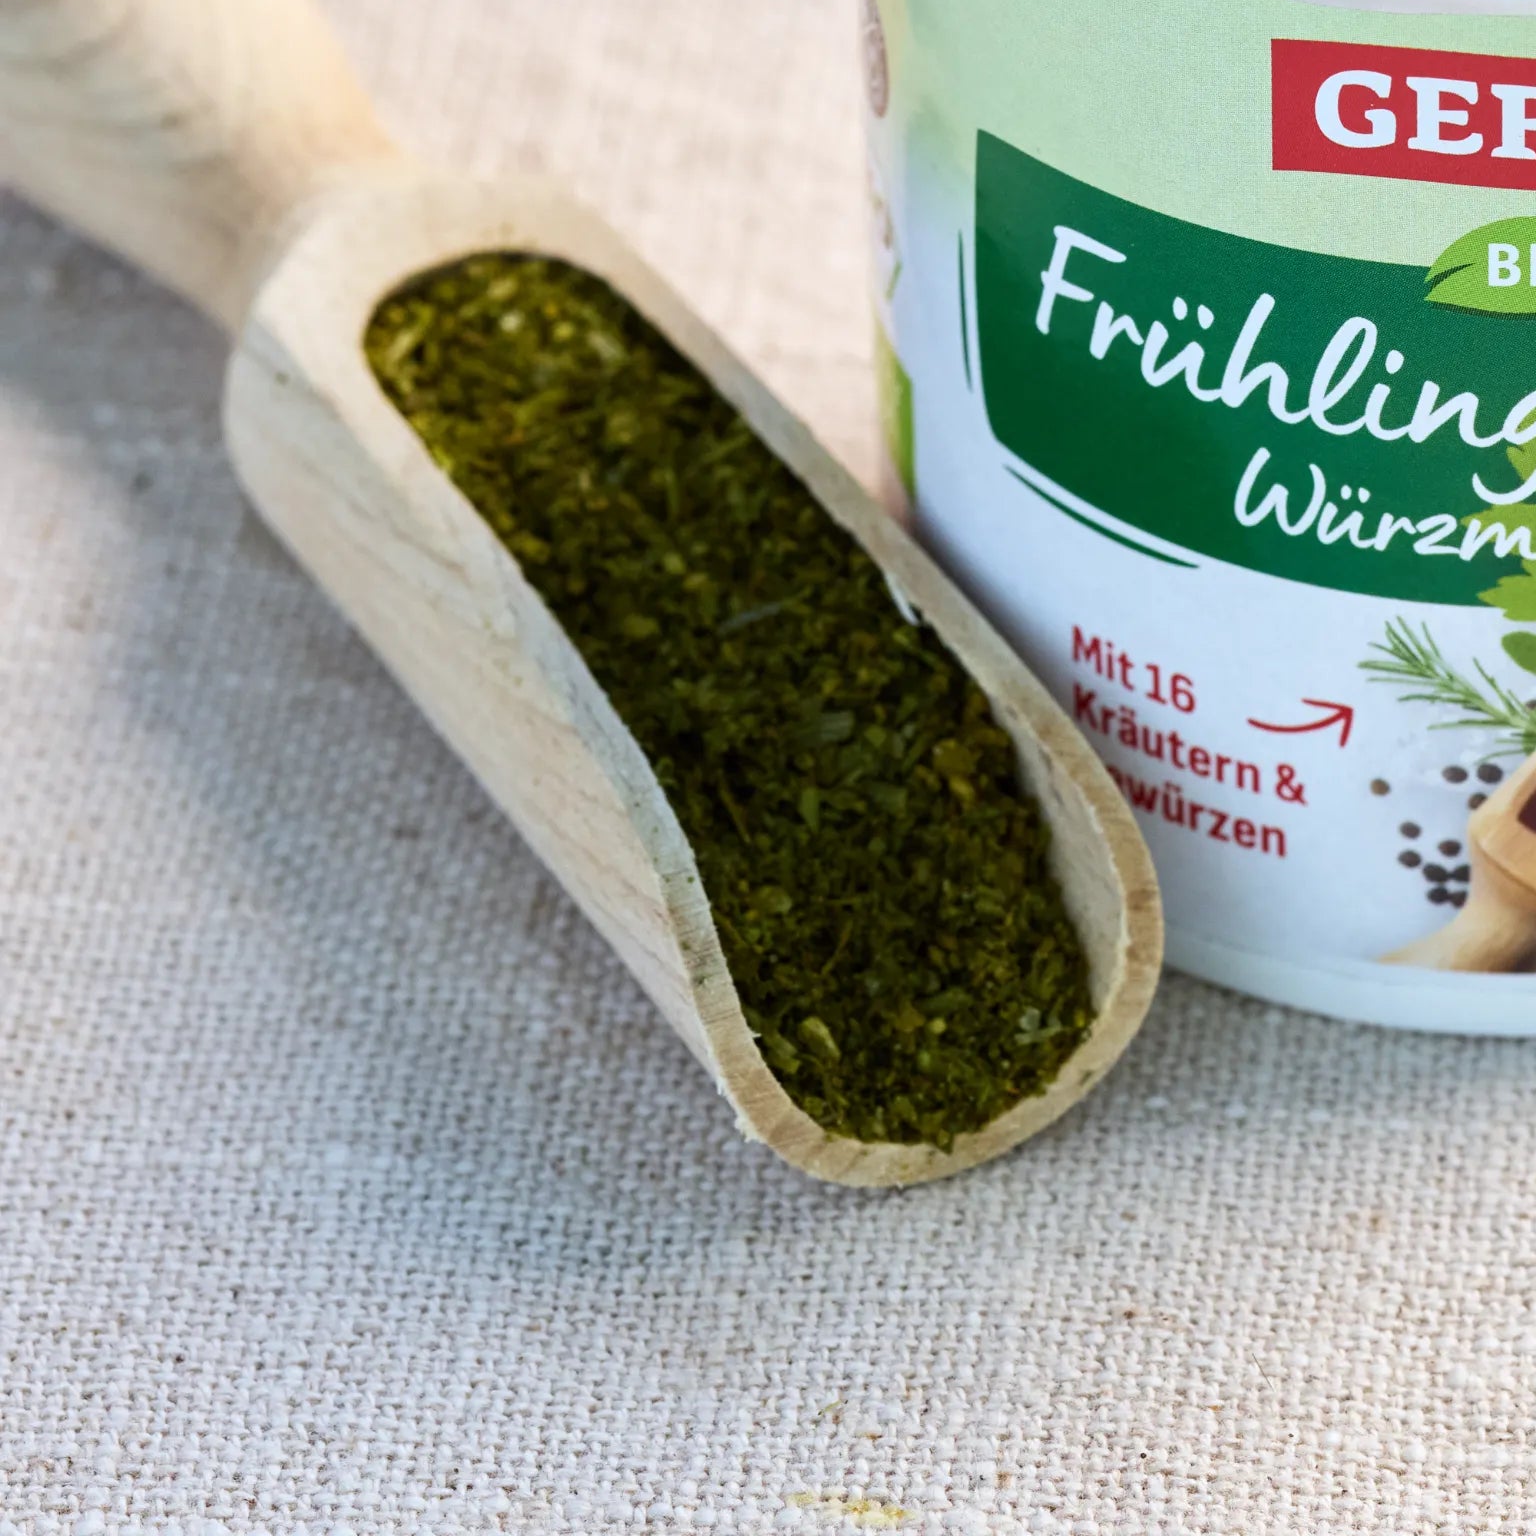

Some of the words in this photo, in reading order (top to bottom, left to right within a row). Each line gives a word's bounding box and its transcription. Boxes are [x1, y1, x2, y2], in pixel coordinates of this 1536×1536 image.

[1071, 625, 1134, 692] Mit
[1144, 663, 1196, 714] 16
[1072, 684, 1260, 793] Kräutern
[1274, 763, 1307, 805] &
[1107, 765, 1287, 857] würzen
